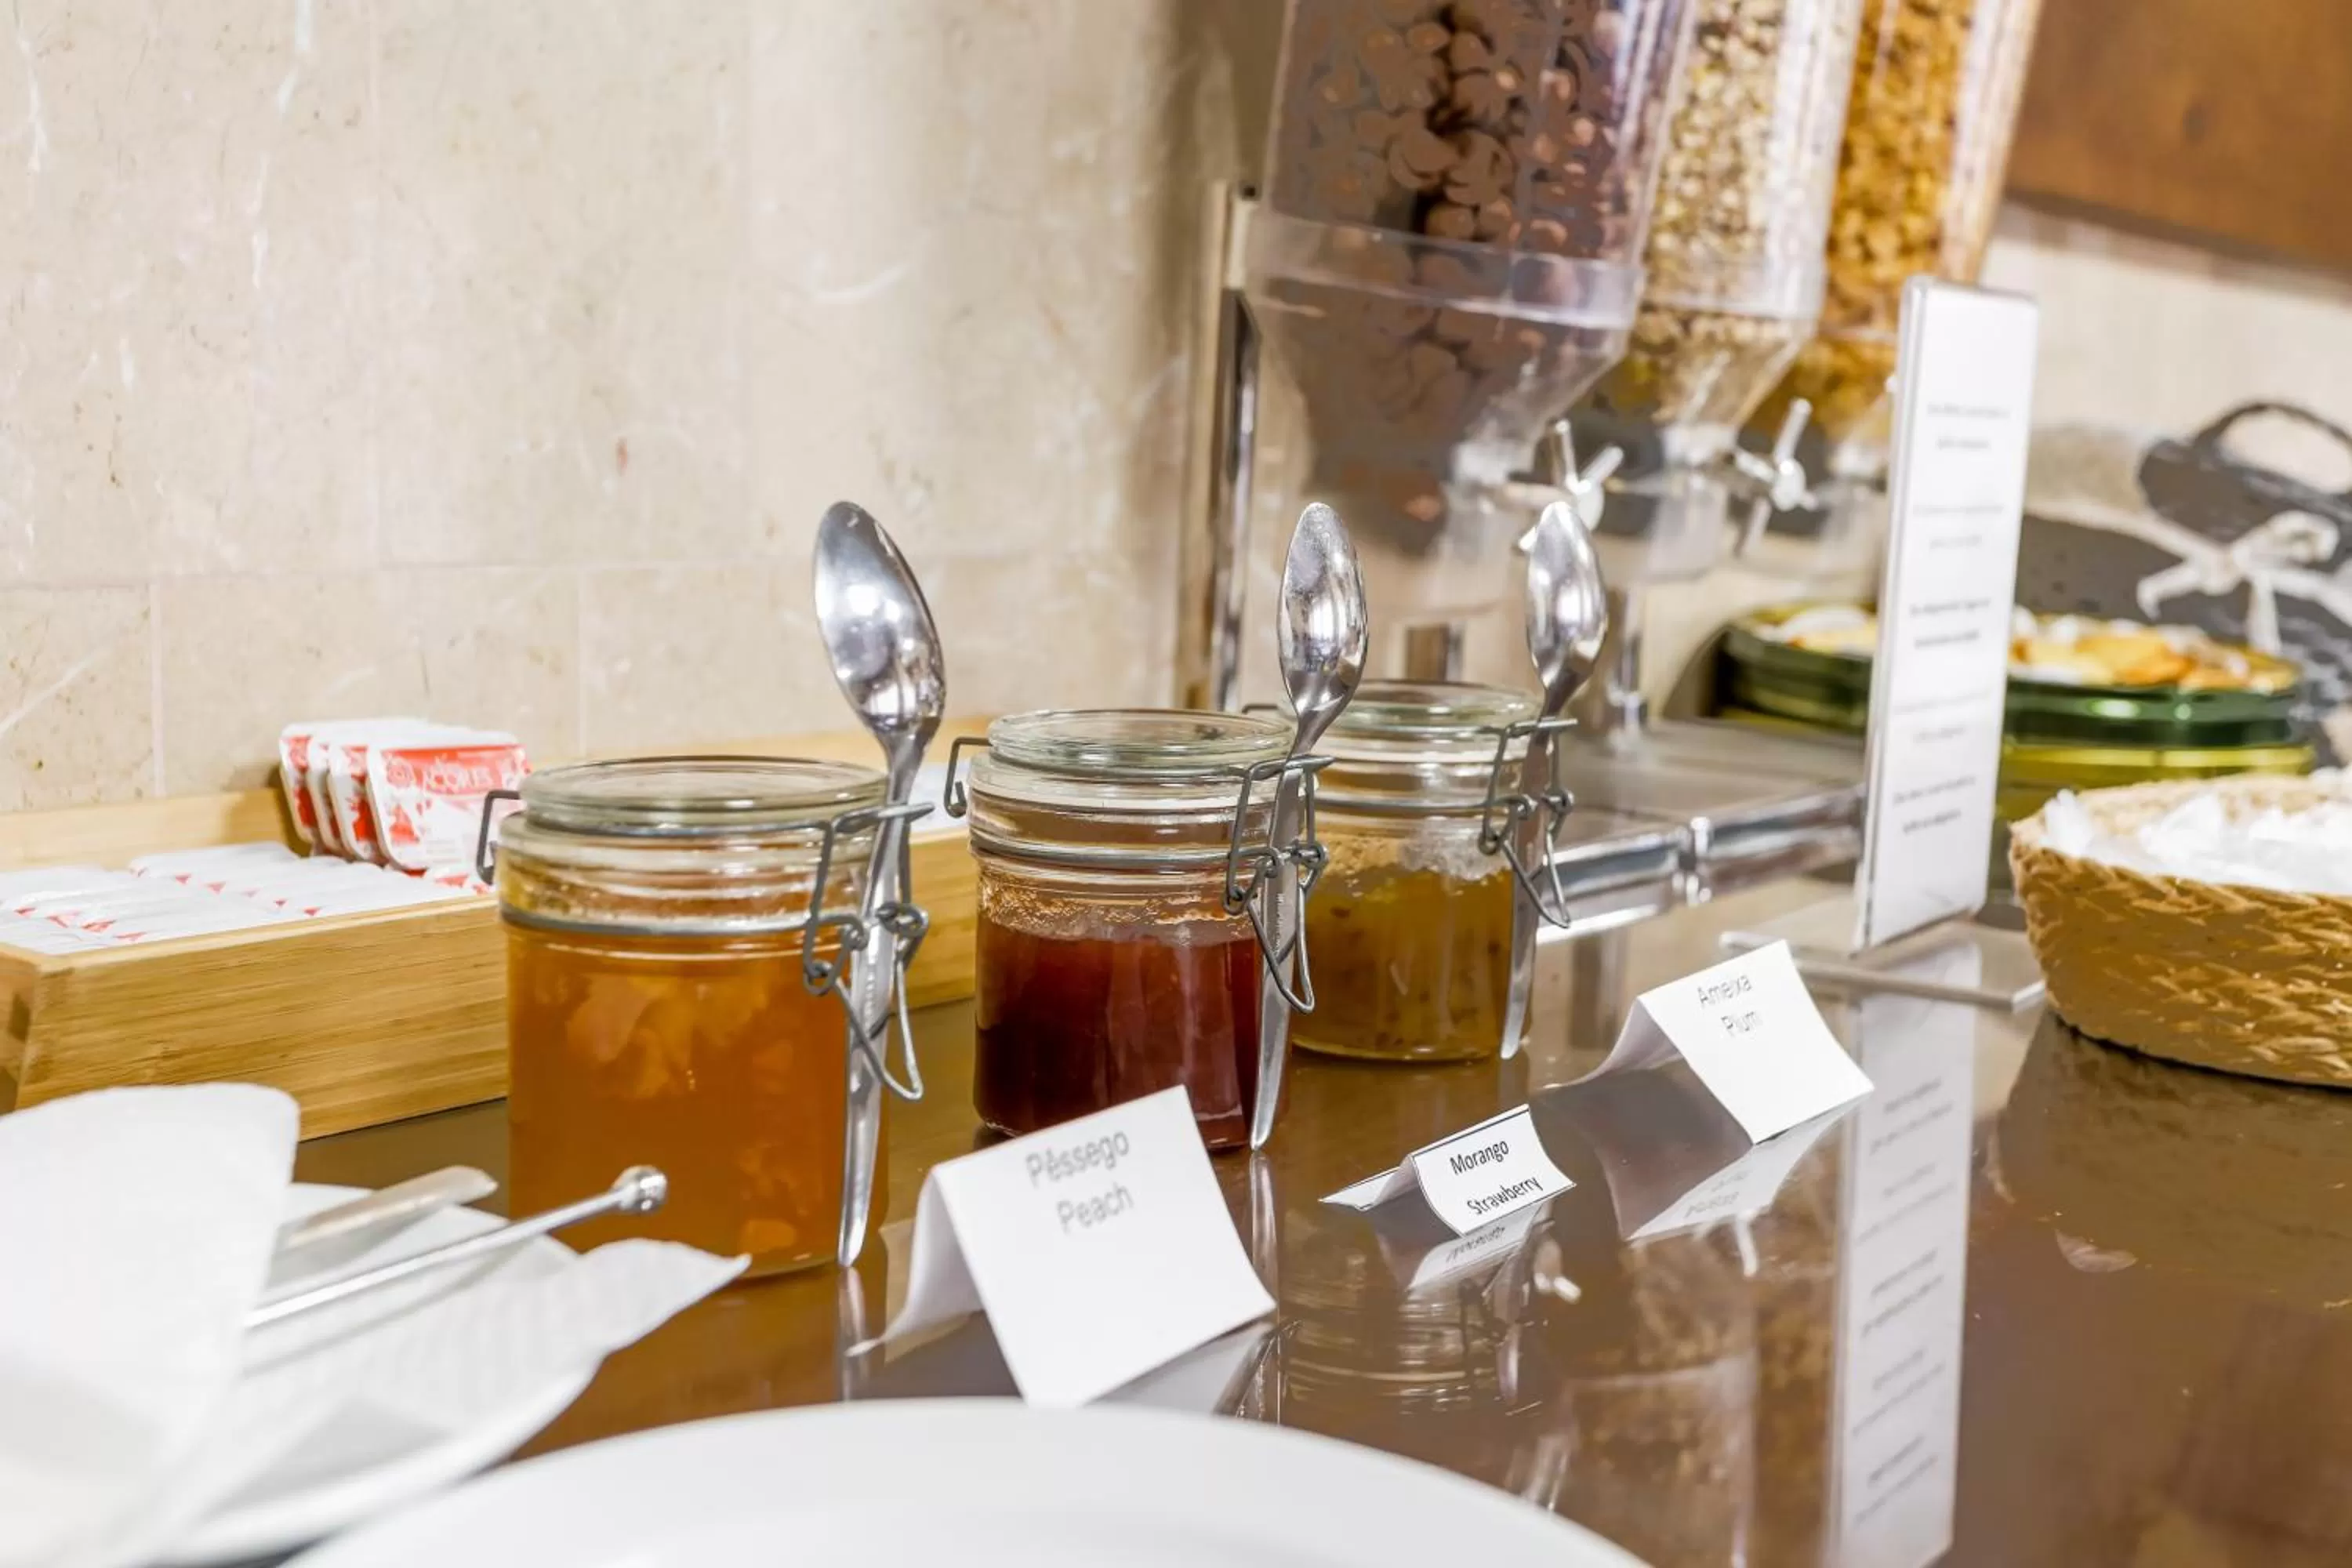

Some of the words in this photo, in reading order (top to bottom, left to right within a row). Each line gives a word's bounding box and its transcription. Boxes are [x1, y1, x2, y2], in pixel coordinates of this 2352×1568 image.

[1450, 1141, 1509, 1174] Morango
[1056, 1182, 1134, 1234] Peach
[1467, 1177, 1544, 1214] Strawberry
